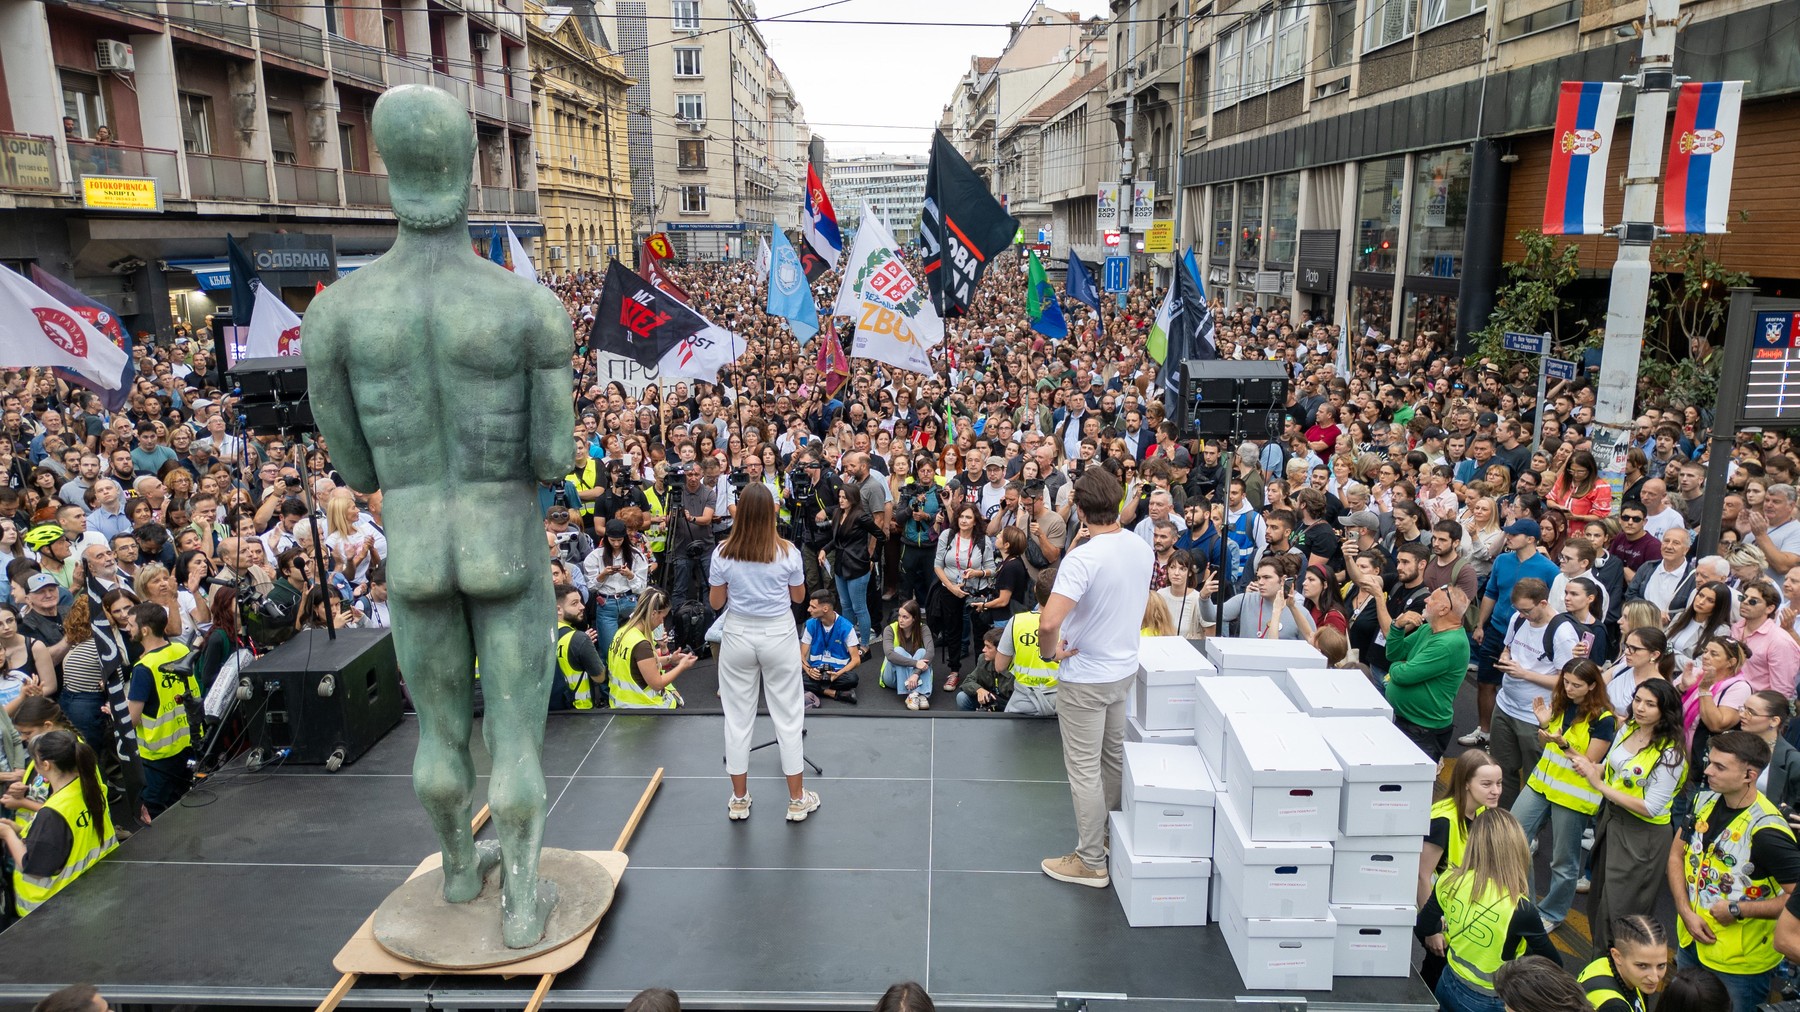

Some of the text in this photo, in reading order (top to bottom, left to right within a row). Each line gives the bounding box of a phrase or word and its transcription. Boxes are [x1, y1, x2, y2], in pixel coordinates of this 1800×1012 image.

[20, 175, 50, 186] DINAR
[90, 181, 148, 191] FOTOKOPIRNICA
[257, 252, 330, 268] ОДБРАНА
[1756, 348, 1783, 359] Линија
